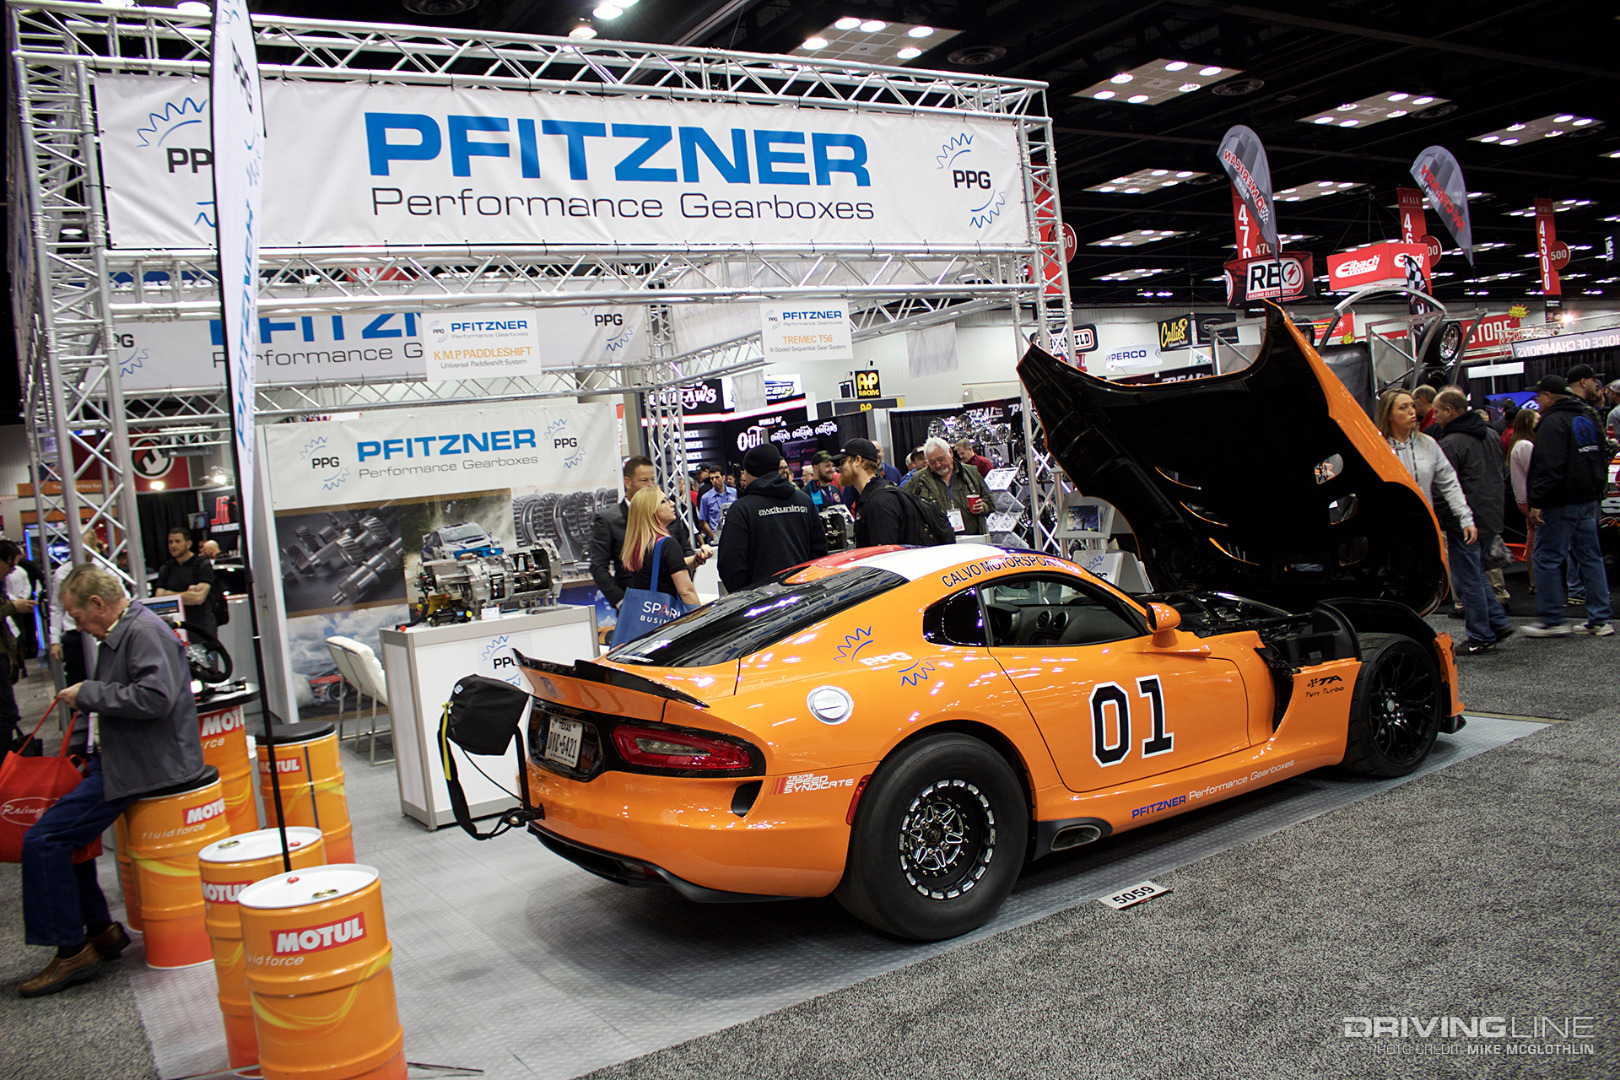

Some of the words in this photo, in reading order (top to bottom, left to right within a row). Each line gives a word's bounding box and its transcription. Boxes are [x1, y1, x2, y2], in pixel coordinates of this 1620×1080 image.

[364, 112, 871, 187] PFITZNER
[166, 147, 214, 174] PP
[952, 169, 992, 189] PPG
[371, 187, 663, 219] Performance
[680, 192, 875, 220] Gearboxes
[1538, 220, 1551, 291] 4500
[1550, 248, 1568, 261] 500
[1335, 254, 1381, 278] Eibach
[1265, 289, 1295, 297] ELECTRNICS
[594, 313, 623, 327] PPG
[782, 310, 842, 320] PFITZNER
[451, 320, 528, 332] PFITZNER
[783, 335, 817, 345] TREMEC
[819, 334, 833, 343] T56
[463, 346, 532, 359] PADDLESHIFT
[791, 345, 816, 353] Sequential
[440, 360, 470, 370] Universal
[470, 359, 503, 369] Paddleshift
[504, 358, 528, 366] System
[856, 372, 879, 390] AP
[858, 389, 880, 397] RACING
[356, 428, 537, 462] PFITZNER
[553, 437, 578, 449] PPG
[311, 456, 340, 469] PPG
[358, 460, 458, 479] Performance
[462, 454, 539, 470] Gearboxes
[941, 564, 983, 588] CALVO
[642, 600, 681, 619] SPAR
[640, 614, 669, 625] BUSIN
[858, 651, 913, 666] PPG
[1322, 686, 1345, 695] Turbo
[559, 721, 572, 732] TEXAS
[1089, 674, 1174, 768] 01
[784, 778, 854, 794] SYNDICATE
[786, 775, 829, 785] SPEED
[1131, 795, 1187, 819] PFITZNER
[1189, 775, 1248, 801] Performance
[1250, 759, 1295, 781] Gearboxes
[186, 797, 226, 824] MOTU
[1112, 886, 1156, 904] 5059
[276, 917, 364, 953] MOTUL
